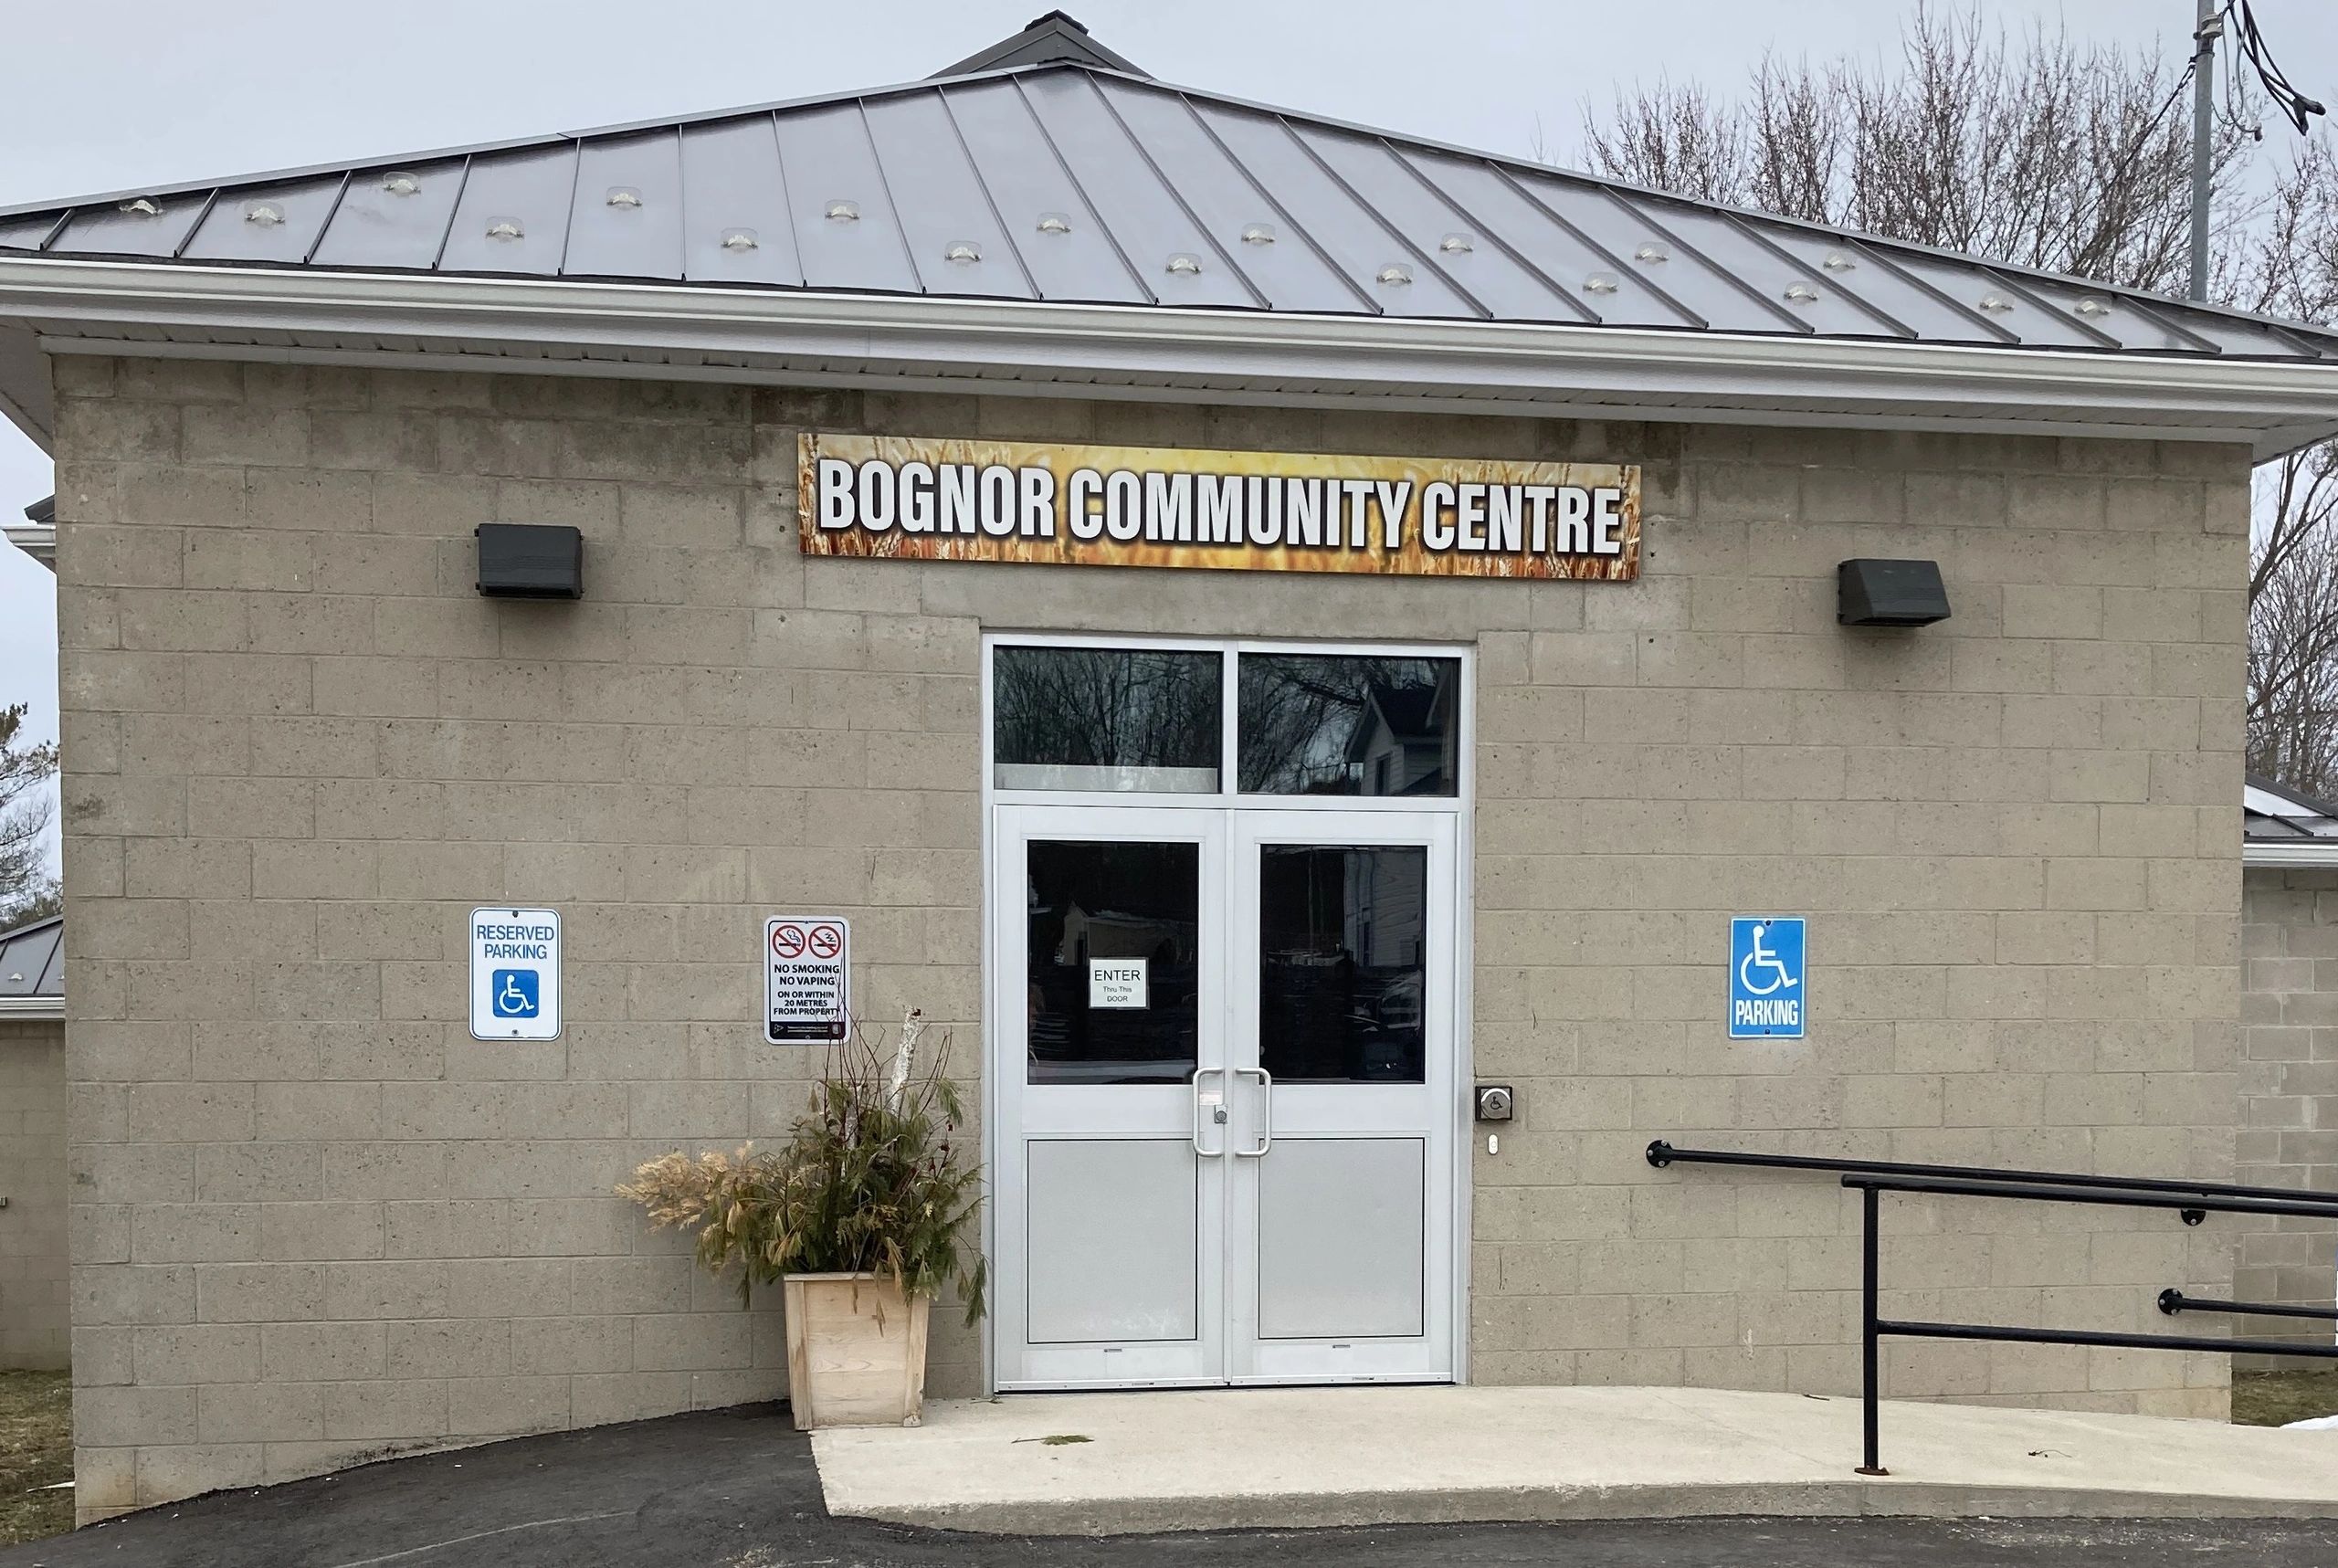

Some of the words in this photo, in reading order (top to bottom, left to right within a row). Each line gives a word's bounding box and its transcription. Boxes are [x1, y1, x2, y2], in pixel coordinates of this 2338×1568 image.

[820, 459, 1055, 537] BOGNOR
[1069, 468, 1412, 548] COMMUNITY
[1423, 481, 1621, 554] CENTRE
[476, 924, 554, 941] RESERVED
[484, 943, 547, 959] PARKING
[774, 963, 790, 973] NO
[792, 963, 840, 974] SMOKING
[779, 976, 795, 985] NO
[796, 976, 836, 986] VAPING
[1094, 969, 1141, 982] ENTER
[805, 991, 835, 999] WITHIN
[1103, 985, 1117, 994] Thru
[1119, 985, 1132, 994] This
[1735, 999, 1798, 1026] PARKING
